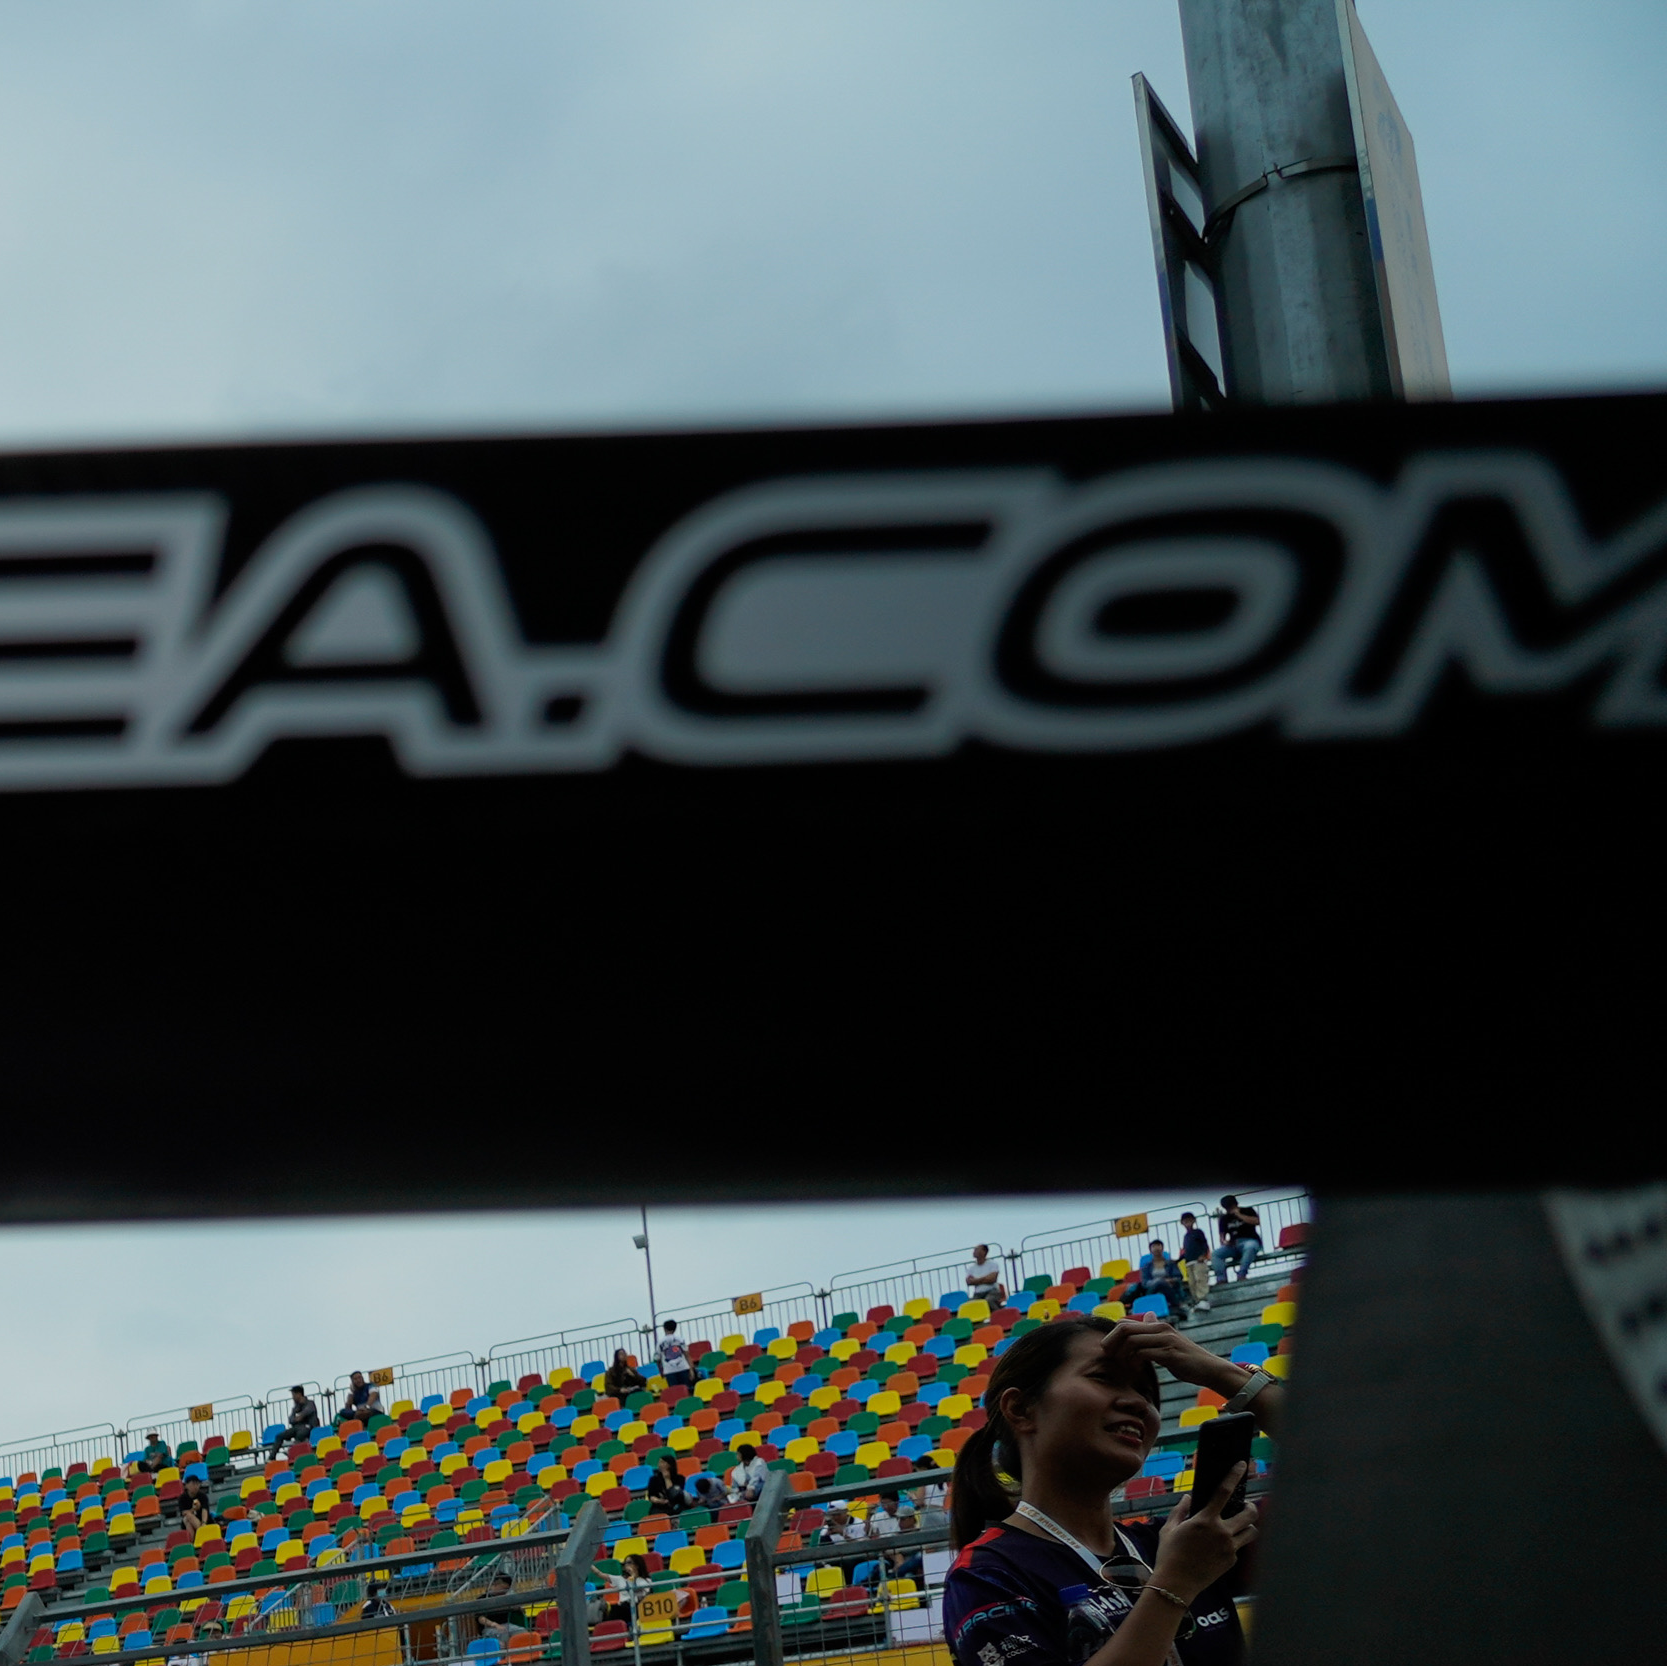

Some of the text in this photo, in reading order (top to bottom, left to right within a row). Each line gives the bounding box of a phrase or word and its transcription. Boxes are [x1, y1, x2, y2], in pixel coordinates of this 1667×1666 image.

[1121, 1217, 1142, 1234] B6
[739, 1297, 758, 1312] B6
[373, 1371, 389, 1385] B6
[643, 1598, 674, 1617] B10
